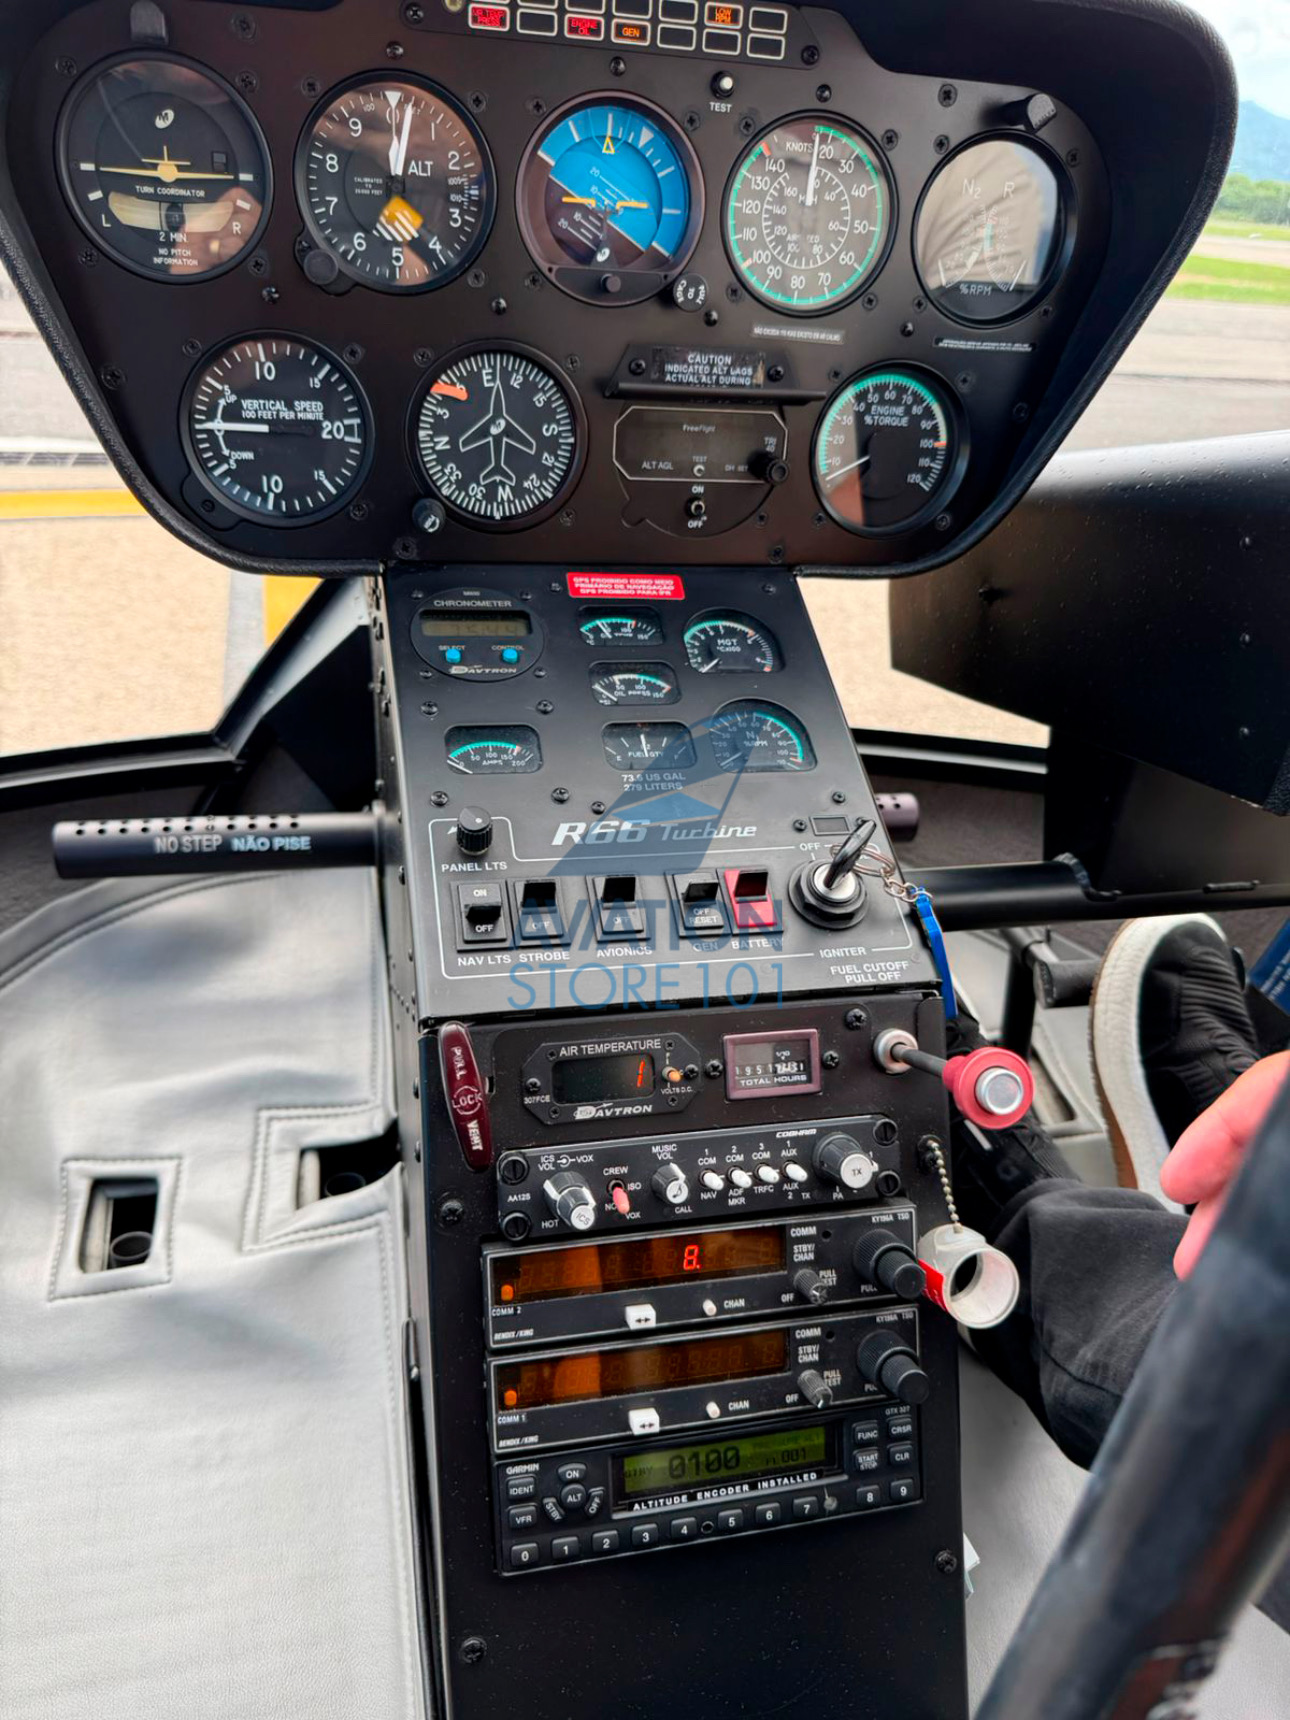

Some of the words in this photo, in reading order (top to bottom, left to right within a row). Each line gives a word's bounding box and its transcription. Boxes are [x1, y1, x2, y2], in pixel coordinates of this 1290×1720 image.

[571, 19, 597, 28] ENGINE
[578, 27, 590, 35] OIL
[622, 27, 640, 37] GEN
[710, 103, 732, 112] TEST
[350, 118, 362, 137] 9
[786, 142, 813, 152] KNOTS
[448, 151, 460, 170] 2
[409, 161, 433, 176] ALT
[765, 159, 785, 173] 140
[136, 185, 154, 194] TURN
[157, 186, 205, 197] COORDINATOR
[102, 214, 111, 227] L
[233, 222, 241, 234] R
[159, 248, 168, 256] NO
[753, 250, 771, 264] 100
[153, 257, 198, 266] INFORMATION
[688, 354, 731, 365] CAUTION
[665, 364, 710, 374] INDICATED
[713, 366, 728, 374] ALT
[730, 367, 753, 376] LAGS
[665, 374, 699, 383] ACTUAL
[701, 375, 717, 383] ALT
[719, 376, 752, 385] DURING
[226, 395, 237, 403] UP
[242, 399, 287, 411] VERTICAL
[295, 401, 323, 412] SPEED
[853, 402, 865, 412] 40
[871, 406, 904, 415] ENGINE
[242, 411, 256, 419] 100
[297, 412, 324, 420] MINUTE
[864, 415, 909, 427] %TORQUE
[322, 421, 344, 439] 20
[920, 439, 933, 448] 100
[231, 451, 254, 460] DOWN
[642, 461, 657, 470] ALT
[659, 462, 673, 471] AGL
[262, 475, 283, 493] 10
[523, 474, 541, 490] 24
[498, 485, 514, 502] W
[692, 486, 704, 494] ON
[688, 520, 703, 528] OFF
[645, 782, 683, 790] LITERS
[551, 819, 651, 845] R66
[659, 822, 757, 842] Turbine
[154, 837, 178, 853] NO
[181, 835, 222, 852] STEP
[231, 835, 270, 851] NÃO
[273, 836, 311, 851] PISE
[800, 843, 820, 851] OFF
[441, 863, 482, 873] PANEL
[485, 861, 507, 871] LTS
[473, 889, 486, 897] ON
[689, 916, 718, 925] RESET
[476, 924, 494, 933] OFF
[693, 942, 718, 952] GEN
[731, 938, 784, 950] BATTERY
[519, 951, 570, 963] STROBE
[597, 947, 652, 958] AVIONICS
[820, 947, 867, 958] IGNITER
[458, 956, 484, 967] NAV
[487, 955, 511, 965] LTS
[830, 965, 861, 976] FUEL
[864, 961, 910, 972] CUTOFF
[844, 973, 876, 984] PULL
[878, 972, 901, 982] OFF
[560, 1046, 578, 1057] AIR
[581, 1039, 661, 1054] TEMPERATURE
[451, 1046, 467, 1080] PULL
[740, 1078, 770, 1086] TOTAL
[774, 1075, 807, 1083] HOURS
[451, 1092, 483, 1109] LOCK
[467, 1119, 483, 1151] VENT
[652, 1144, 677, 1153] MUSIC
[781, 1148, 797, 1157] AUX
[541, 1155, 555, 1163] ICS
[657, 1152, 673, 1160] VOL
[698, 1156, 717, 1165] COM
[725, 1154, 744, 1162] COM
[752, 1151, 770, 1160] COM
[538, 1163, 555, 1171] VOL
[603, 1166, 628, 1176] CREW
[852, 1168, 862, 1176] TX
[627, 1183, 642, 1191] ISO
[754, 1185, 774, 1194] TRFC
[782, 1182, 799, 1190] AUX
[701, 1192, 717, 1200] NAV
[728, 1188, 743, 1196] ADF
[788, 1191, 793, 1199] 2
[833, 1192, 844, 1200] PA
[507, 1194, 531, 1202] AA12S
[728, 1197, 746, 1206] MKR
[674, 1206, 693, 1215] CALL
[541, 1219, 559, 1229] HOT
[575, 1213, 590, 1226] ICS
[790, 1226, 816, 1237] COMM
[793, 1243, 816, 1253] STBY/
[793, 1252, 814, 1262] CHAN
[819, 1269, 836, 1278] PULL
[781, 1293, 794, 1303] OFF
[724, 1298, 745, 1309] CHAN
[492, 1307, 514, 1316] COMM
[517, 1306, 522, 1314] 2
[795, 1327, 821, 1339] COMM
[798, 1344, 819, 1354] STBY/
[799, 1354, 819, 1363] CHAN
[824, 1370, 840, 1378] PULL
[786, 1394, 799, 1403] OFF
[728, 1400, 749, 1410] CHAN
[498, 1416, 519, 1424] COMM
[891, 1424, 912, 1434] CRSR
[857, 1430, 878, 1440] FUNC
[858, 1454, 878, 1463] START
[895, 1452, 909, 1461] CLR
[669, 1446, 740, 1480] 0100
[860, 1461, 878, 1470] STOP
[506, 1463, 539, 1475] GARMIN
[566, 1470, 579, 1478] ON
[510, 1485, 534, 1495] IDENT
[633, 1495, 688, 1510] ALTITUDE
[697, 1484, 750, 1500] ENCODER
[758, 1472, 817, 1490] INSTALLED
[567, 1493, 582, 1502] ALT
[589, 1497, 600, 1514] OFF
[545, 1502, 562, 1521] STBY
[515, 1515, 532, 1524] VFR
[642, 1532, 649, 1542] 3
[521, 1551, 529, 1561] 0
